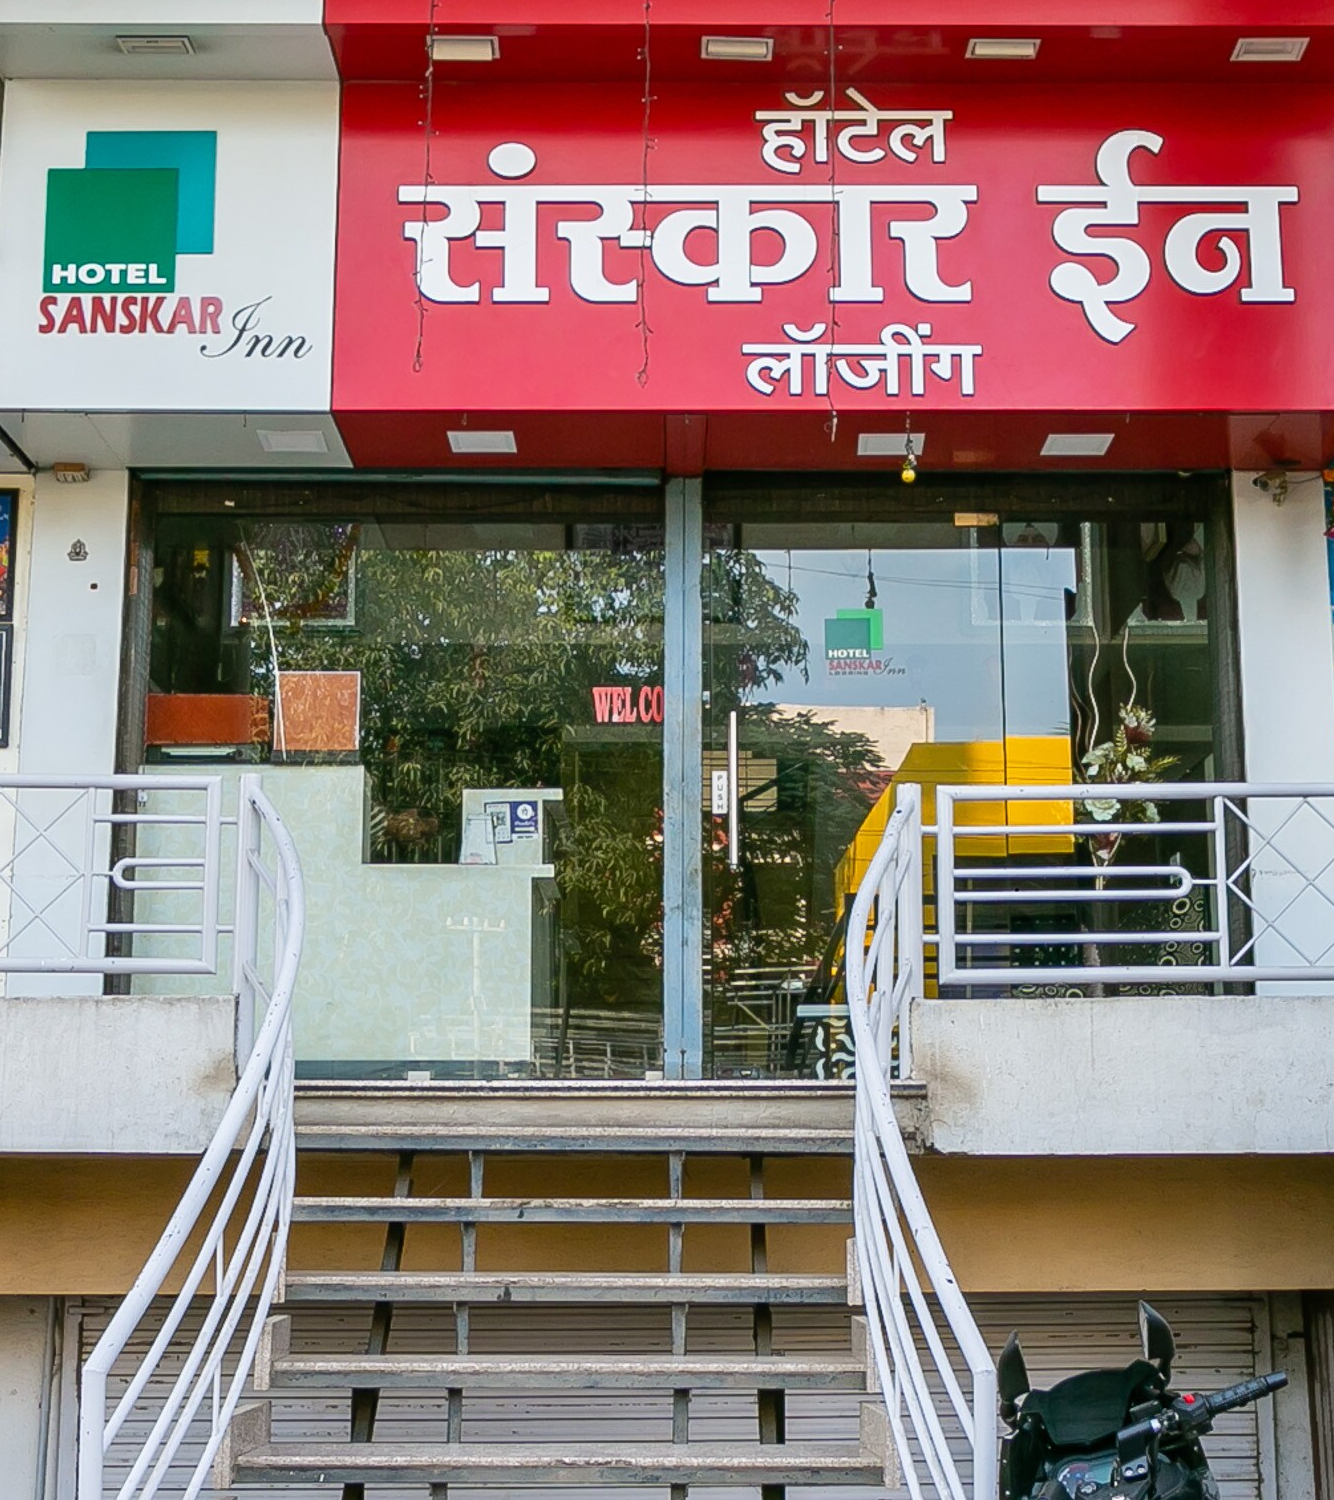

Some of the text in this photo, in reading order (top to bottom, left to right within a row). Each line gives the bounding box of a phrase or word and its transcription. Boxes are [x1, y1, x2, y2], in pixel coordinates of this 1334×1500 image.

[755, 88, 953, 175] हॉटेल
[396, 129, 1299, 346] संस्कार ईन
[51, 263, 166, 285] HOTEL
[38, 295, 313, 360] SANSKAR Inn
[828, 649, 870, 658] HOTEL
[828, 660, 882, 671] SANSKAR
